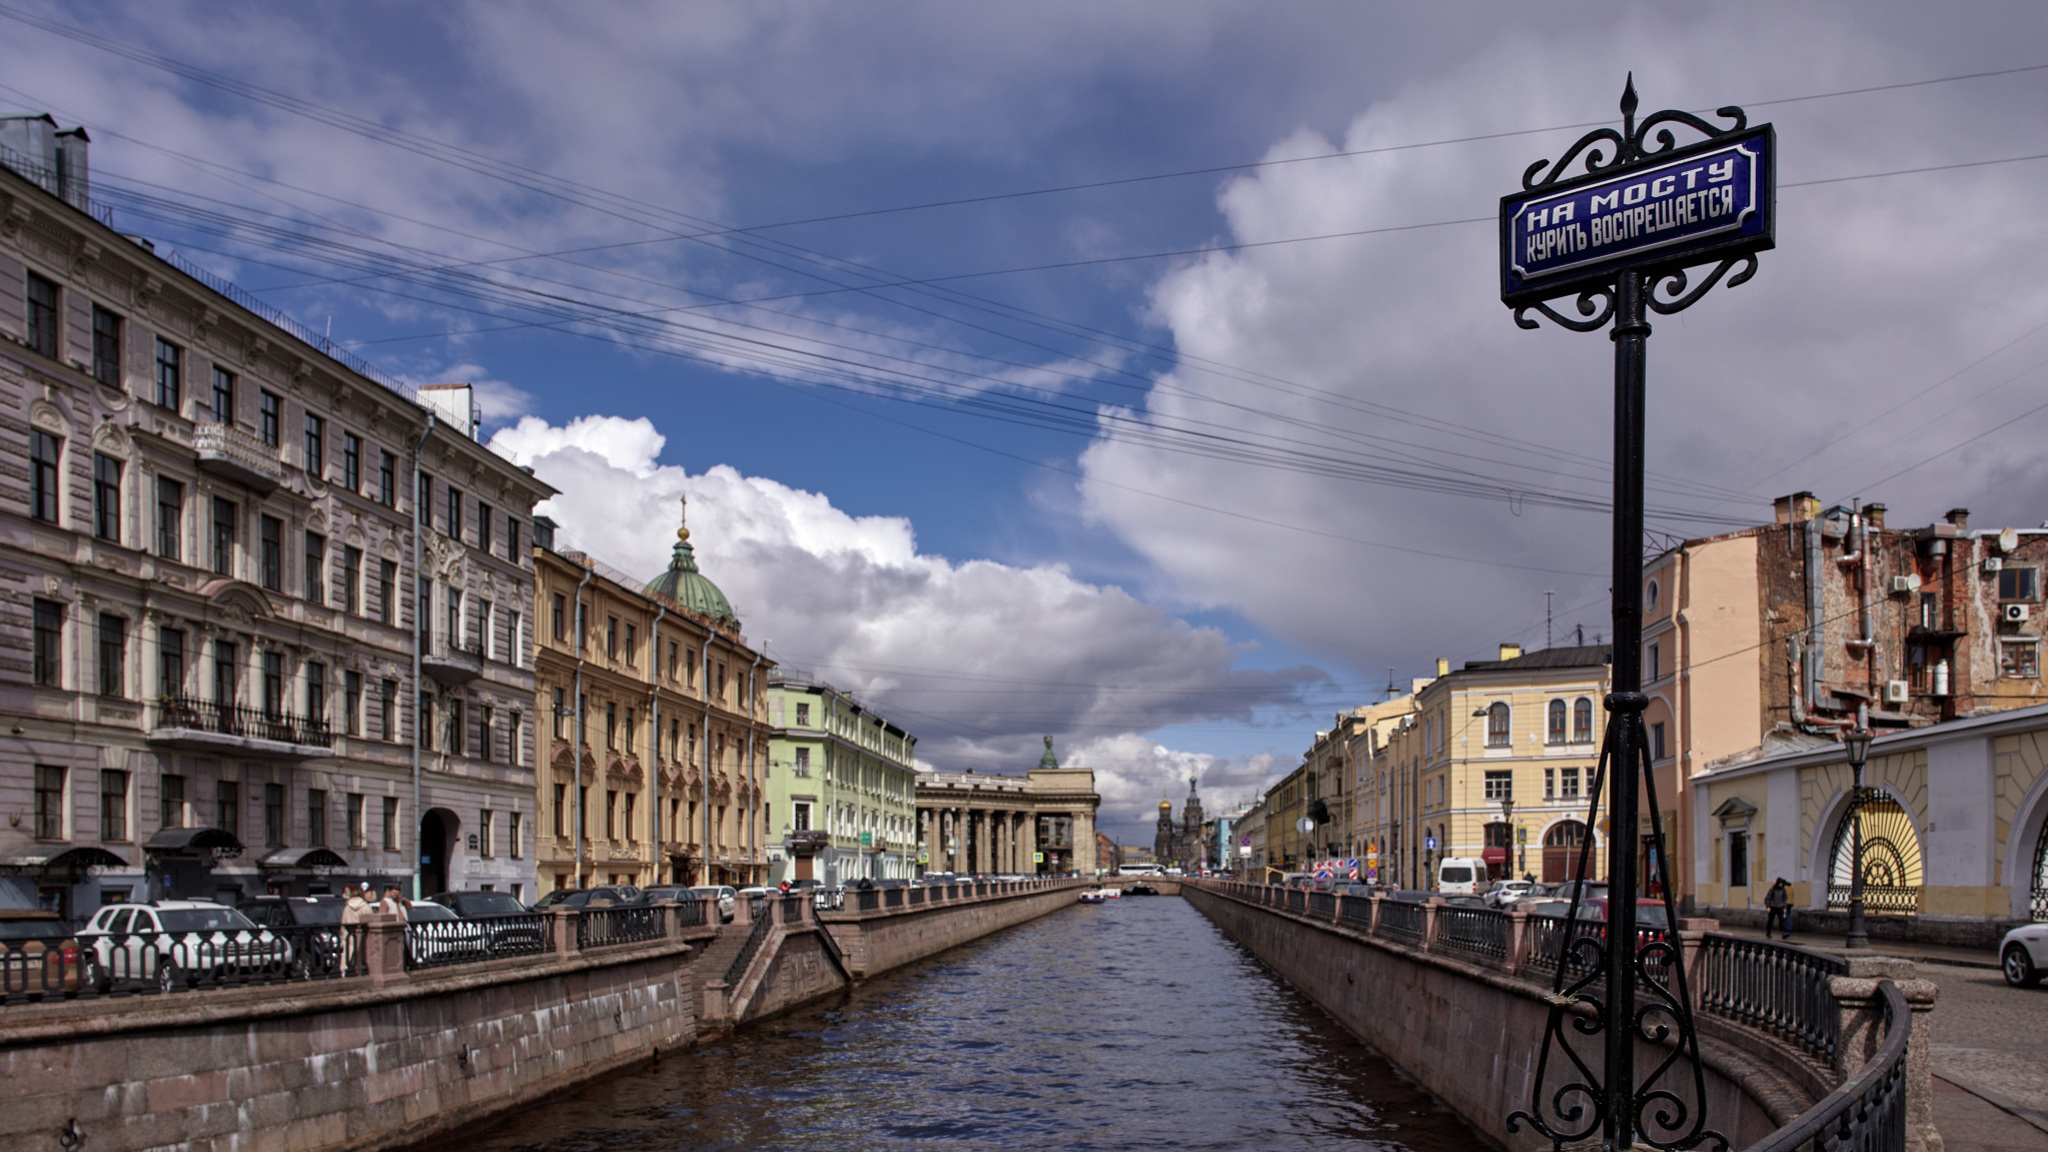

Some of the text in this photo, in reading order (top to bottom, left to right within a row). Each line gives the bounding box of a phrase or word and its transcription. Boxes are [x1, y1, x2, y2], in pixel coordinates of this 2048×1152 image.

[1527, 159, 1734, 233] НА МОСТУ
[1527, 184, 1733, 263] КУРИТЬ ВОСПРЕЩАЕТСЯ
